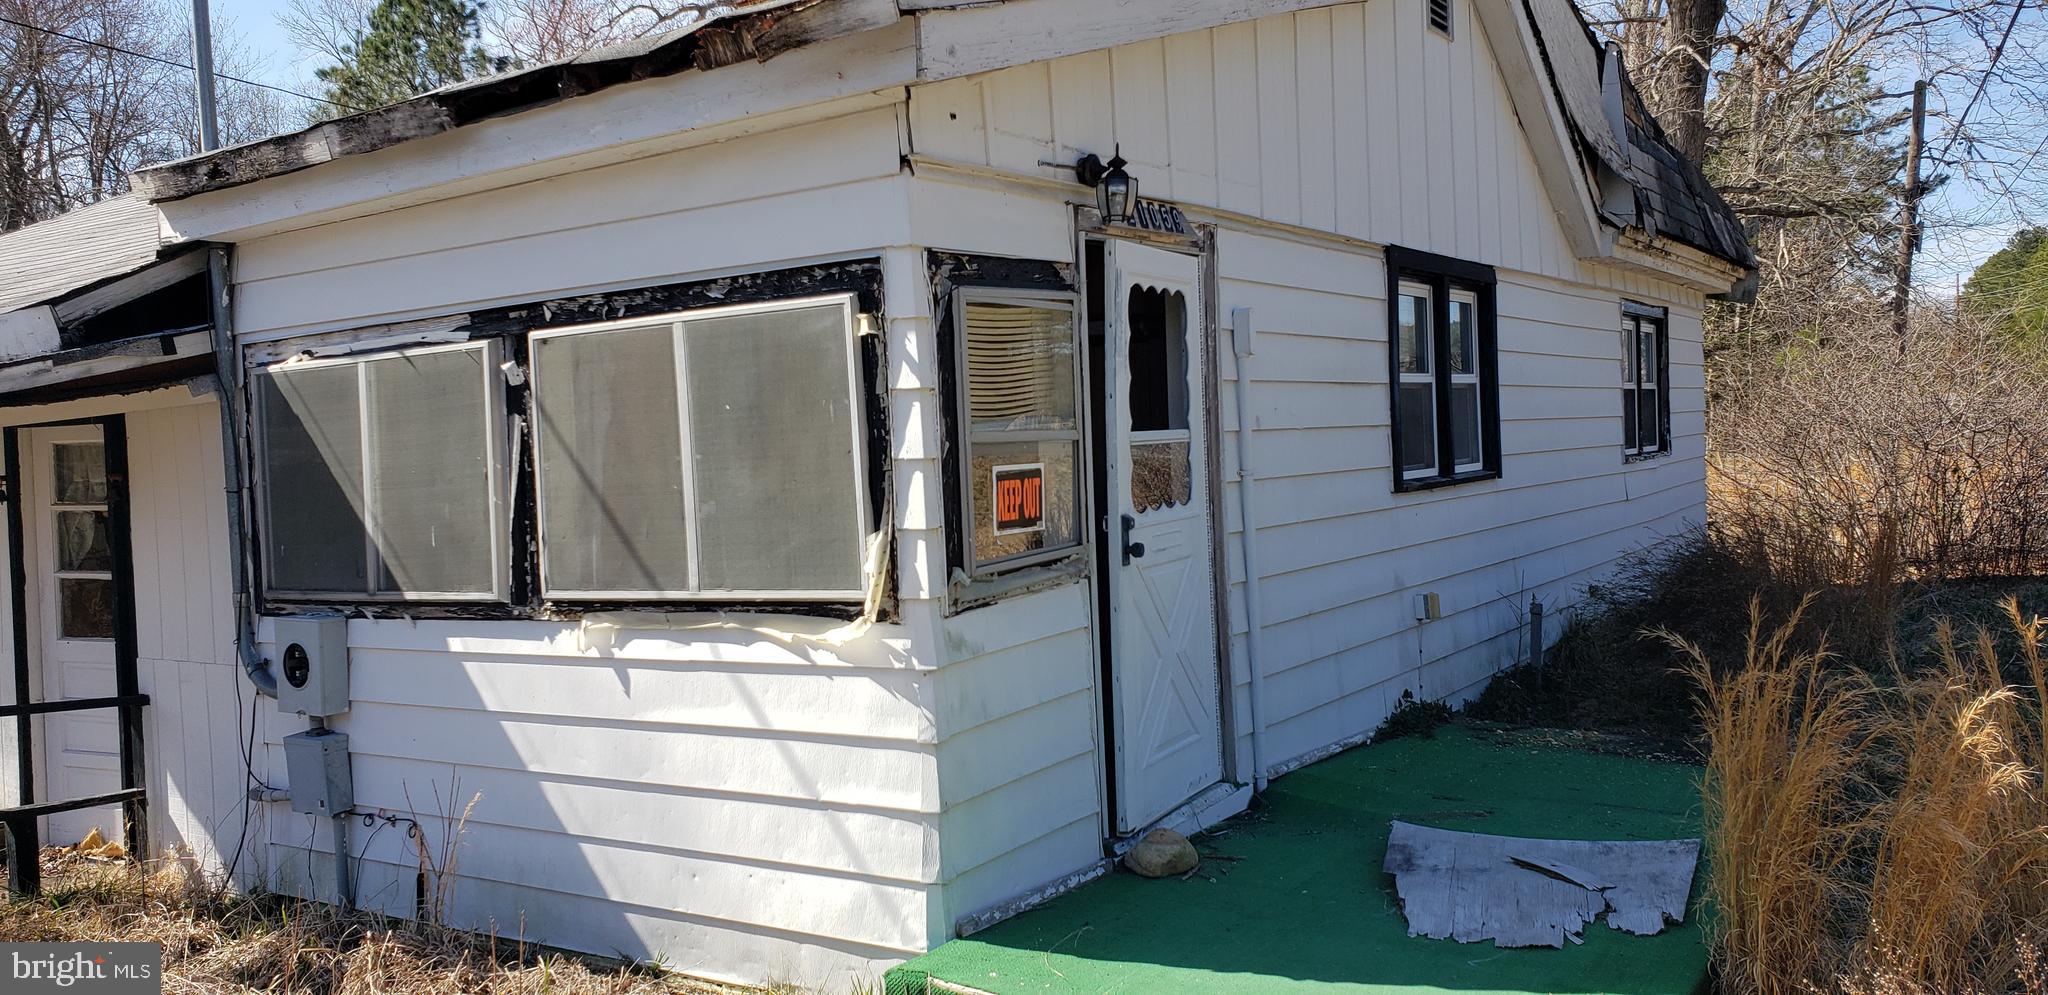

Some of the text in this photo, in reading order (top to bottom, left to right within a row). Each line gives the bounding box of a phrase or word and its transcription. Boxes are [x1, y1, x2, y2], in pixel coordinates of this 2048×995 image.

[1128, 202, 1184, 232] 1059
[998, 477, 1041, 522] KEEP OUT
